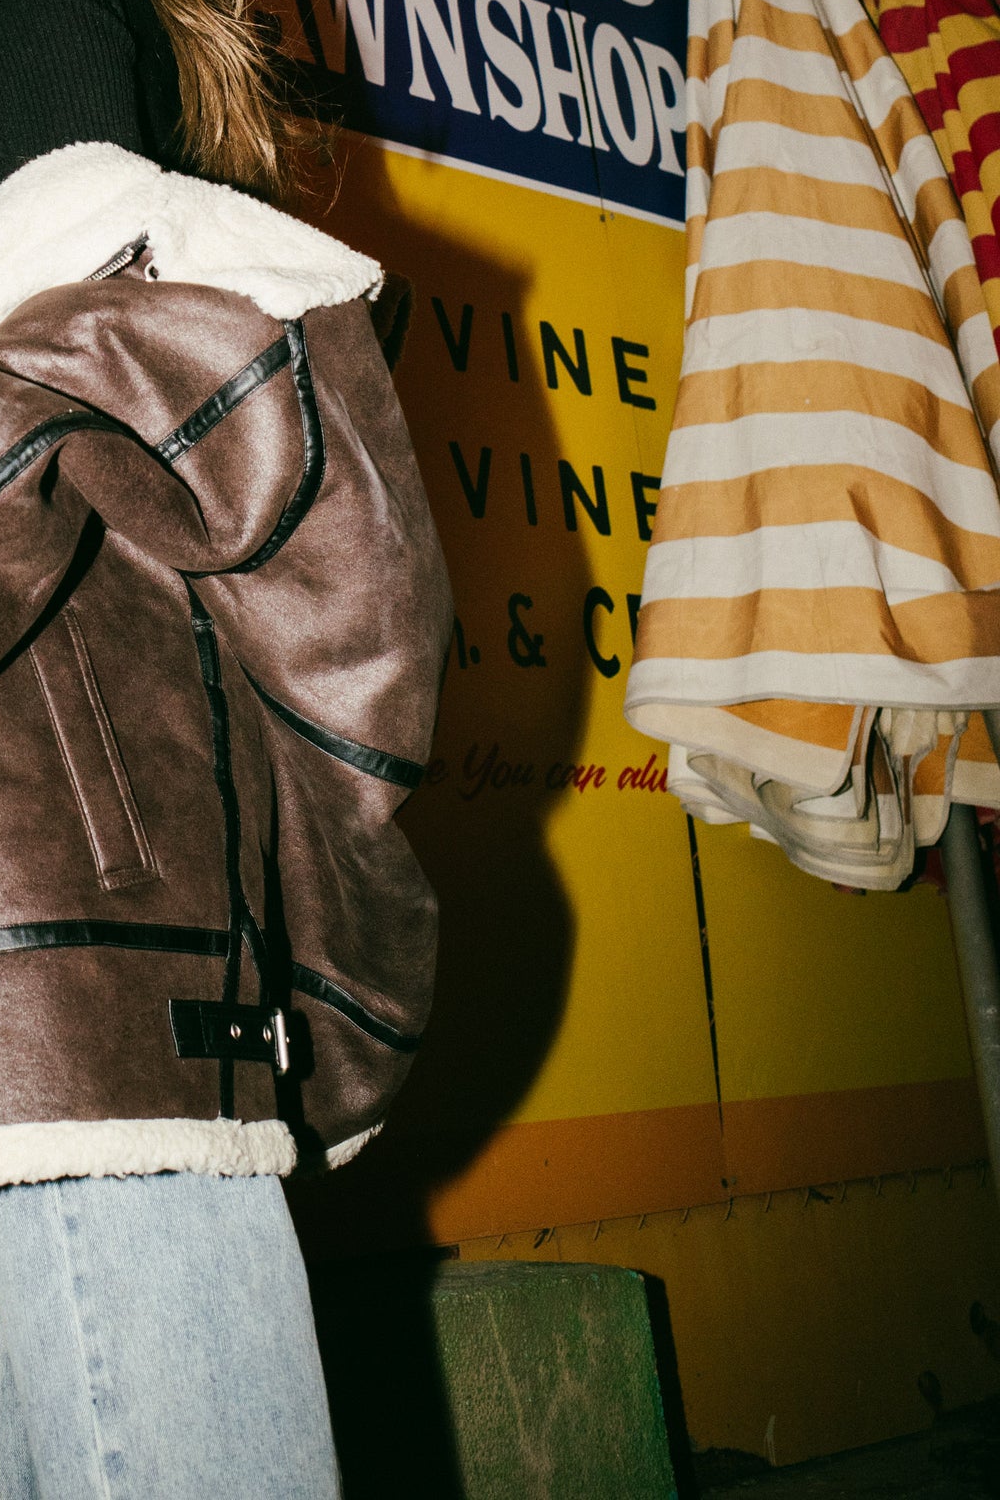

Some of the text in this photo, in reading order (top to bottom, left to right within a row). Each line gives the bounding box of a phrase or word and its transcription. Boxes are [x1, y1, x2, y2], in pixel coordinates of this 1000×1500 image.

[431, 296, 656, 411] VINE
[449, 441, 661, 541] VINE
[508, 592, 546, 667] &
[545, 762, 606, 793] can
